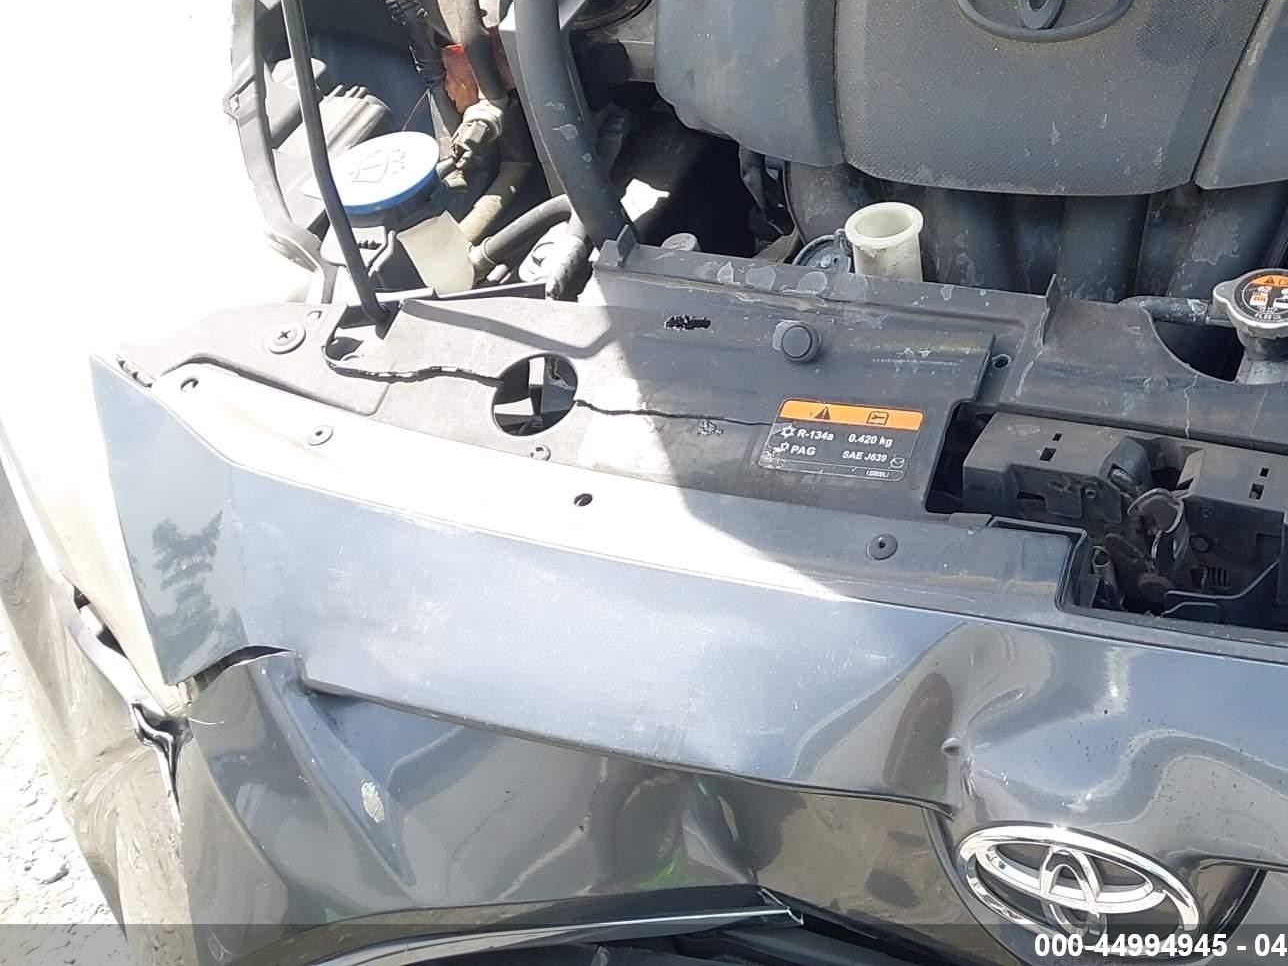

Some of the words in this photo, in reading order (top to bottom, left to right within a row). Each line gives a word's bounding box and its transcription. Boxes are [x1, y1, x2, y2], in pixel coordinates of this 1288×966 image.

[796, 429, 834, 441] R-134a
[848, 433, 878, 444] 0.420
[879, 435, 893, 447] kg
[790, 444, 816, 455] PAG
[842, 450, 864, 460] SAE
[864, 452, 888, 462] J639
